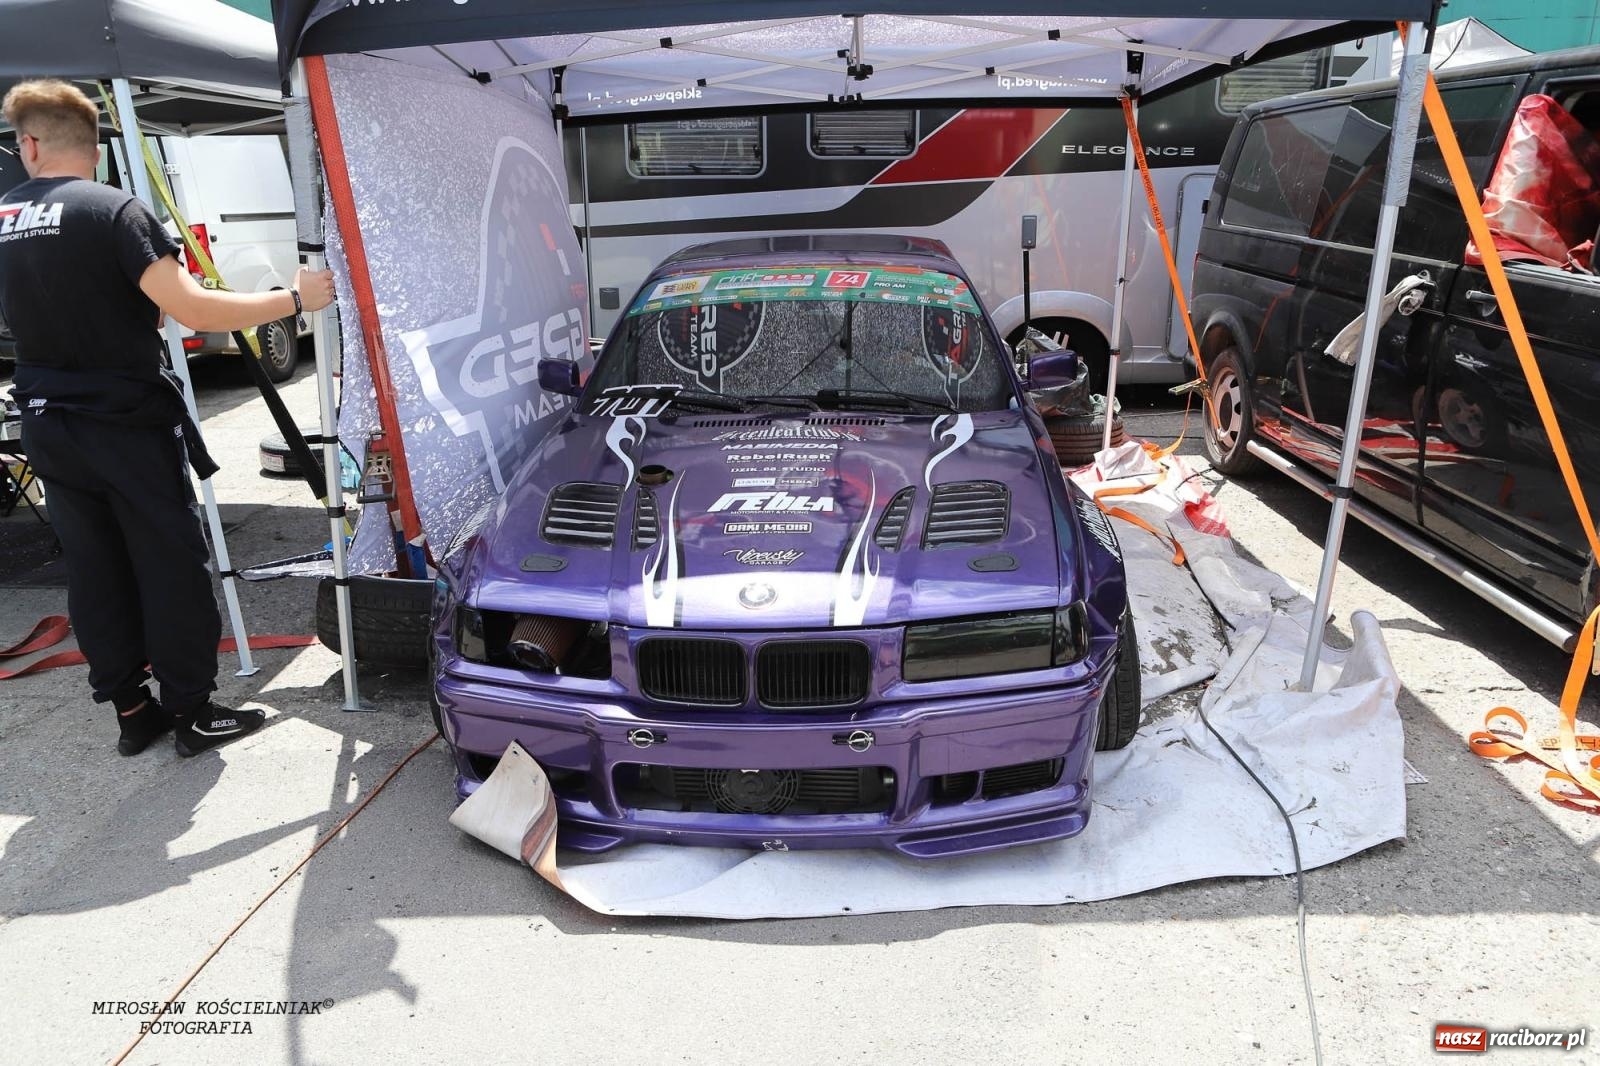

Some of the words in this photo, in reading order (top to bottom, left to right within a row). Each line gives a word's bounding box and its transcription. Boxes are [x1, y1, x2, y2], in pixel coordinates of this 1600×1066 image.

[1061, 144, 1195, 156] ELEGNCE
[30, 228, 60, 237] STYLING
[835, 273, 859, 284] 74
[690, 315, 698, 358] TEAM
[764, 523, 808, 531] MEDIA
[211, 719, 238, 729] sparco
